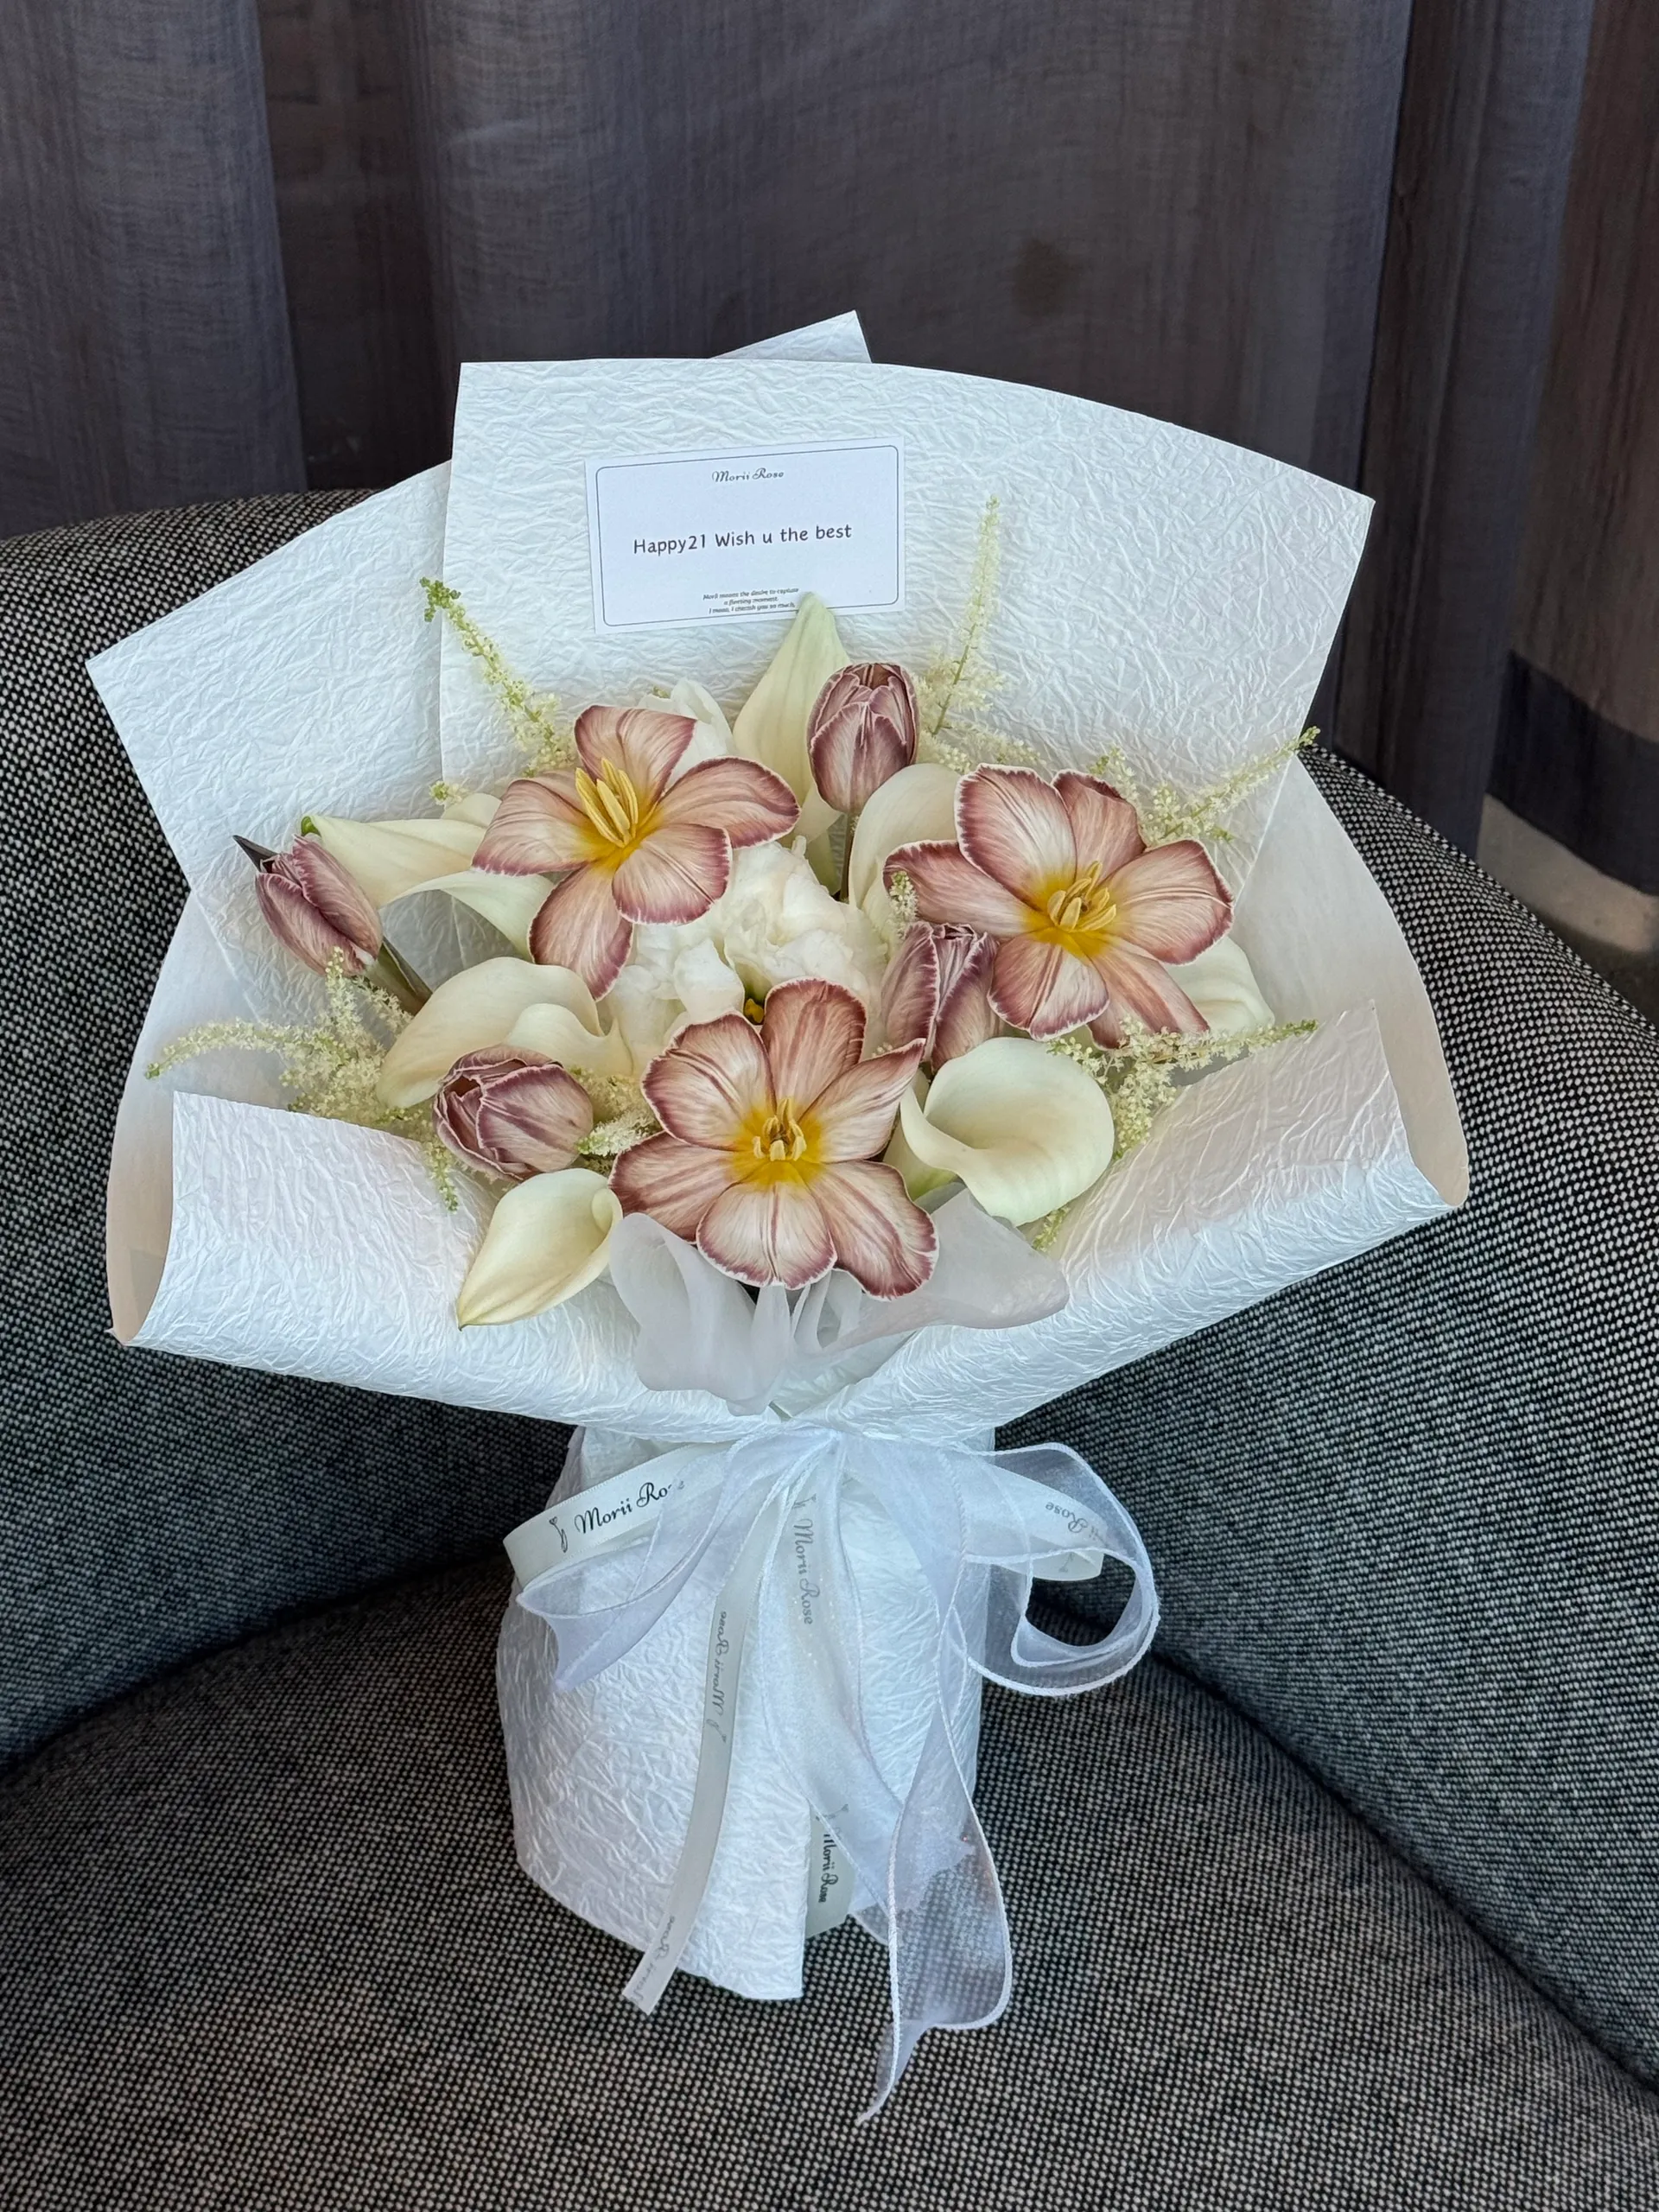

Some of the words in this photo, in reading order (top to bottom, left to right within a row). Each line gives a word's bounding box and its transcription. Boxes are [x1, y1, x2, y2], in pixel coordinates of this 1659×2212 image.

[711, 470, 750, 482] Morii
[752, 467, 785, 480] Rose
[633, 533, 705, 556] Happy21
[715, 530, 755, 548] Wish
[762, 532, 772, 544] u
[779, 527, 809, 543] the
[816, 524, 852, 540] best
[574, 1497, 633, 1535] Morii
[793, 1518, 815, 1575] Morii
[799, 1578, 821, 1624] Rose
